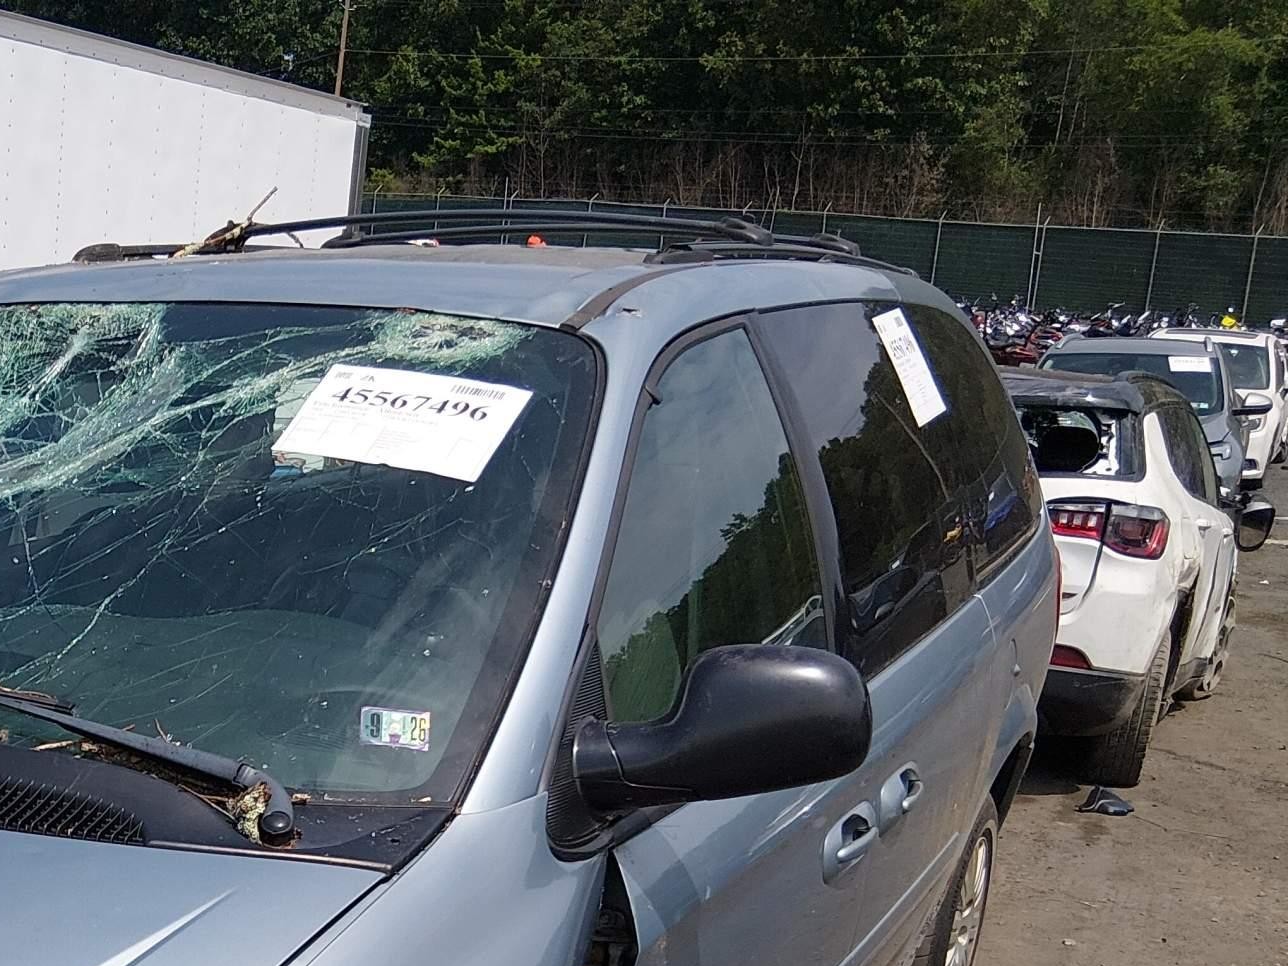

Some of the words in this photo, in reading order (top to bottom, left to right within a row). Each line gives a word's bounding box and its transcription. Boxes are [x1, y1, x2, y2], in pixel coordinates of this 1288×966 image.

[331, 386, 492, 422] 45567496
[370, 712, 381, 738] 9
[410, 716, 427, 742] 26
